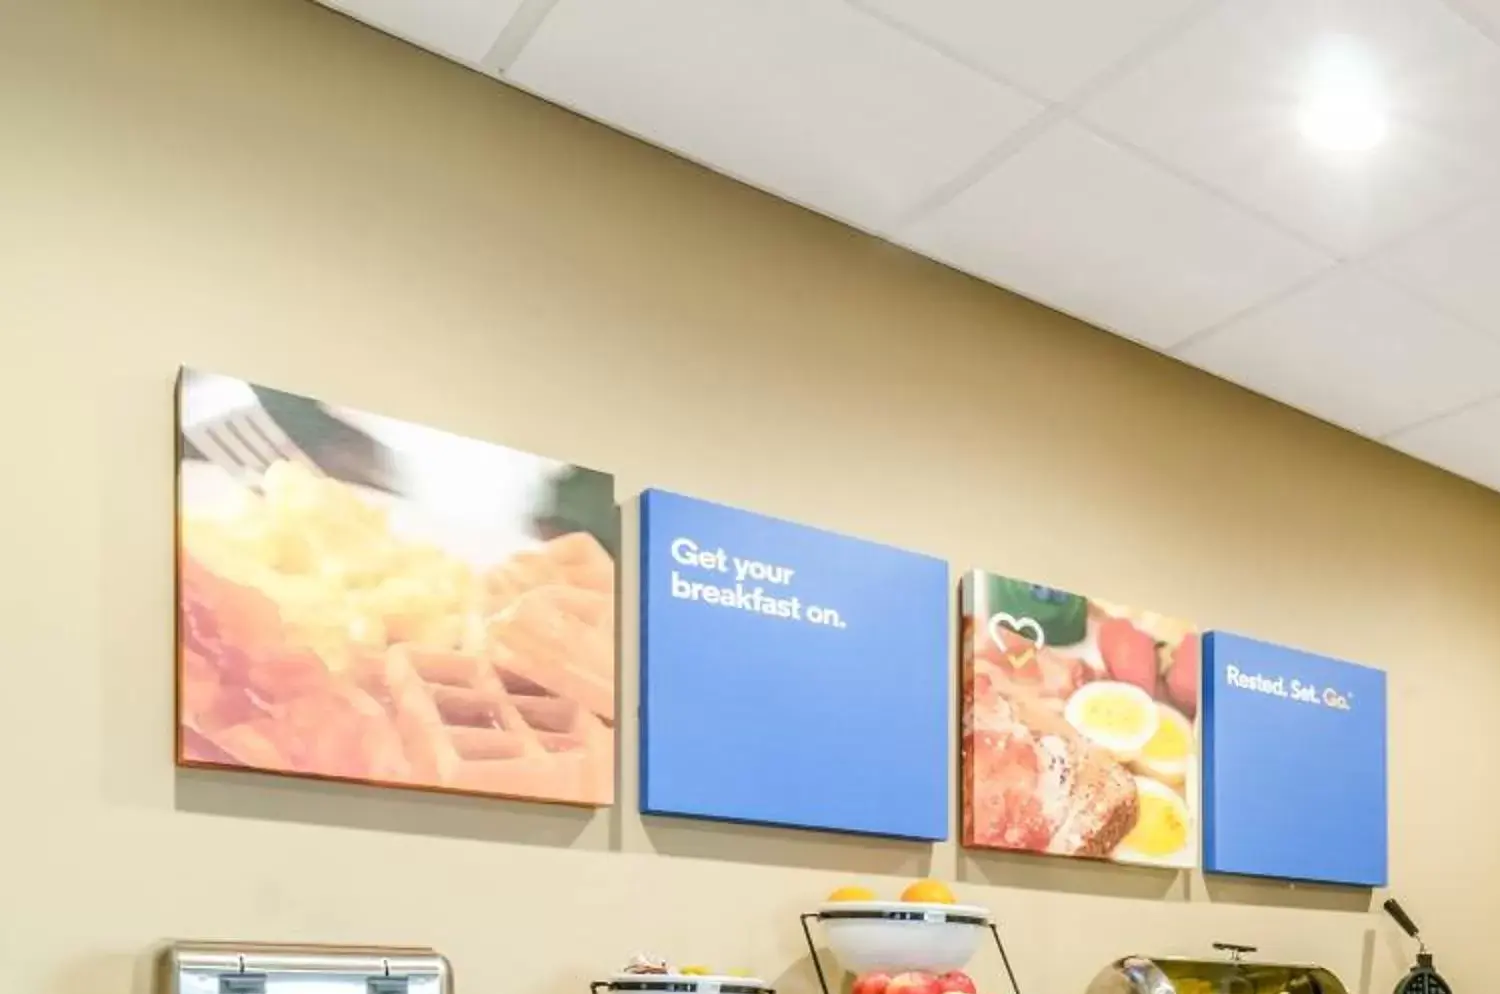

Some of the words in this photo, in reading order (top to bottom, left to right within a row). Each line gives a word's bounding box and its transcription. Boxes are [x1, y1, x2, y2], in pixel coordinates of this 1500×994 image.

[671, 537, 728, 573] Get
[733, 557, 795, 585] your
[671, 570, 800, 620] breakfast
[806, 604, 847, 629] on.
[1226, 664, 1289, 697] Rested.
[1291, 679, 1321, 704] Set.
